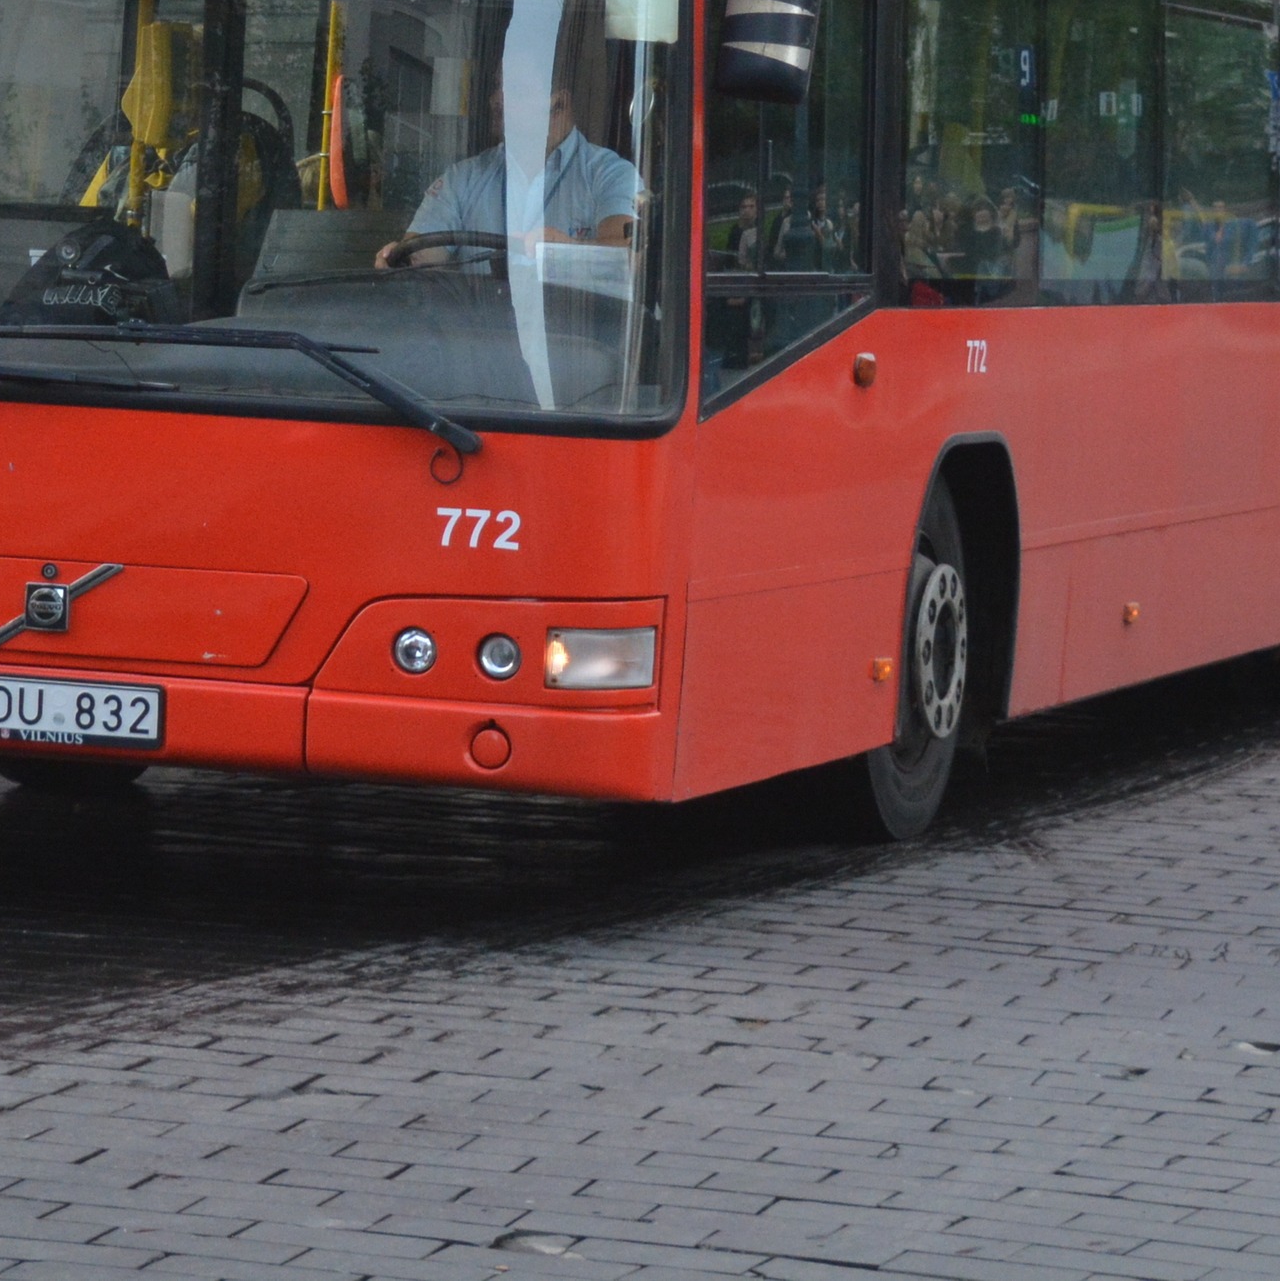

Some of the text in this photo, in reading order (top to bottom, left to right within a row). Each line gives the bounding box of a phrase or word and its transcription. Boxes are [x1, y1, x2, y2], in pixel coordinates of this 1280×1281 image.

[966, 339, 987, 373] 772
[437, 507, 521, 551] 772
[74, 692, 151, 735] 832
[19, 729, 84, 745] VILNIUS
